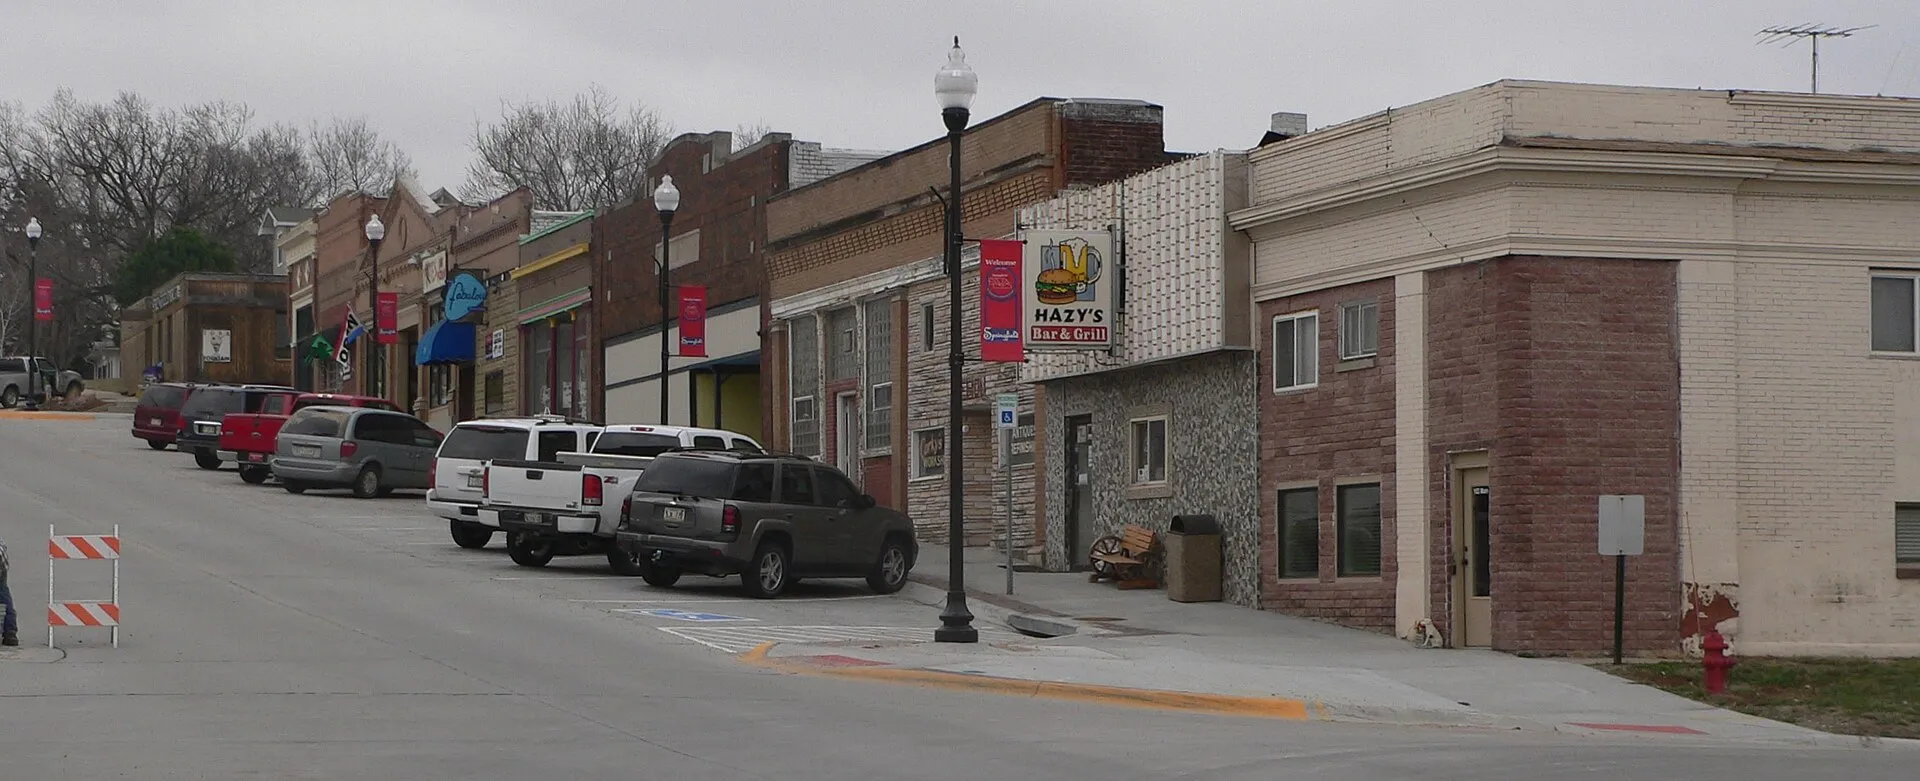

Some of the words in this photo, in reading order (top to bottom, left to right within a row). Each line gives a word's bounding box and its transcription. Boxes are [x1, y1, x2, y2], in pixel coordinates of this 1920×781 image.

[1035, 308, 1103, 323] HAZY'S
[1032, 327, 1058, 340] Bar
[1060, 328, 1071, 340] &
[1073, 328, 1106, 340] Grill
